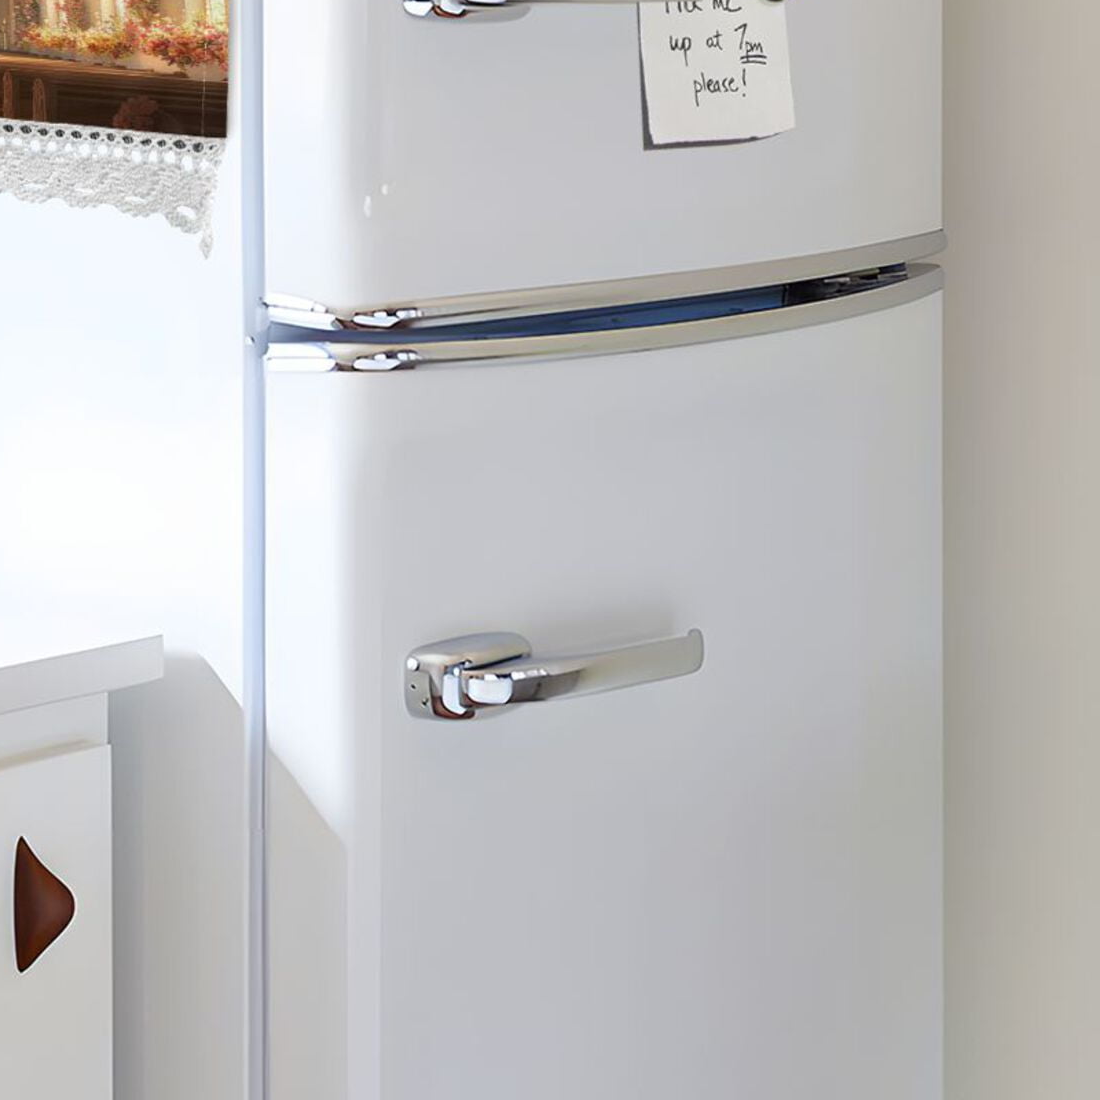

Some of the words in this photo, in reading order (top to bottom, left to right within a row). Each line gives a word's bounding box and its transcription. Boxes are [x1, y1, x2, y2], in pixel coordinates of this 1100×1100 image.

[669, 34, 692, 67] up
[705, 29, 723, 51] at
[693, 67, 747, 107] please!
